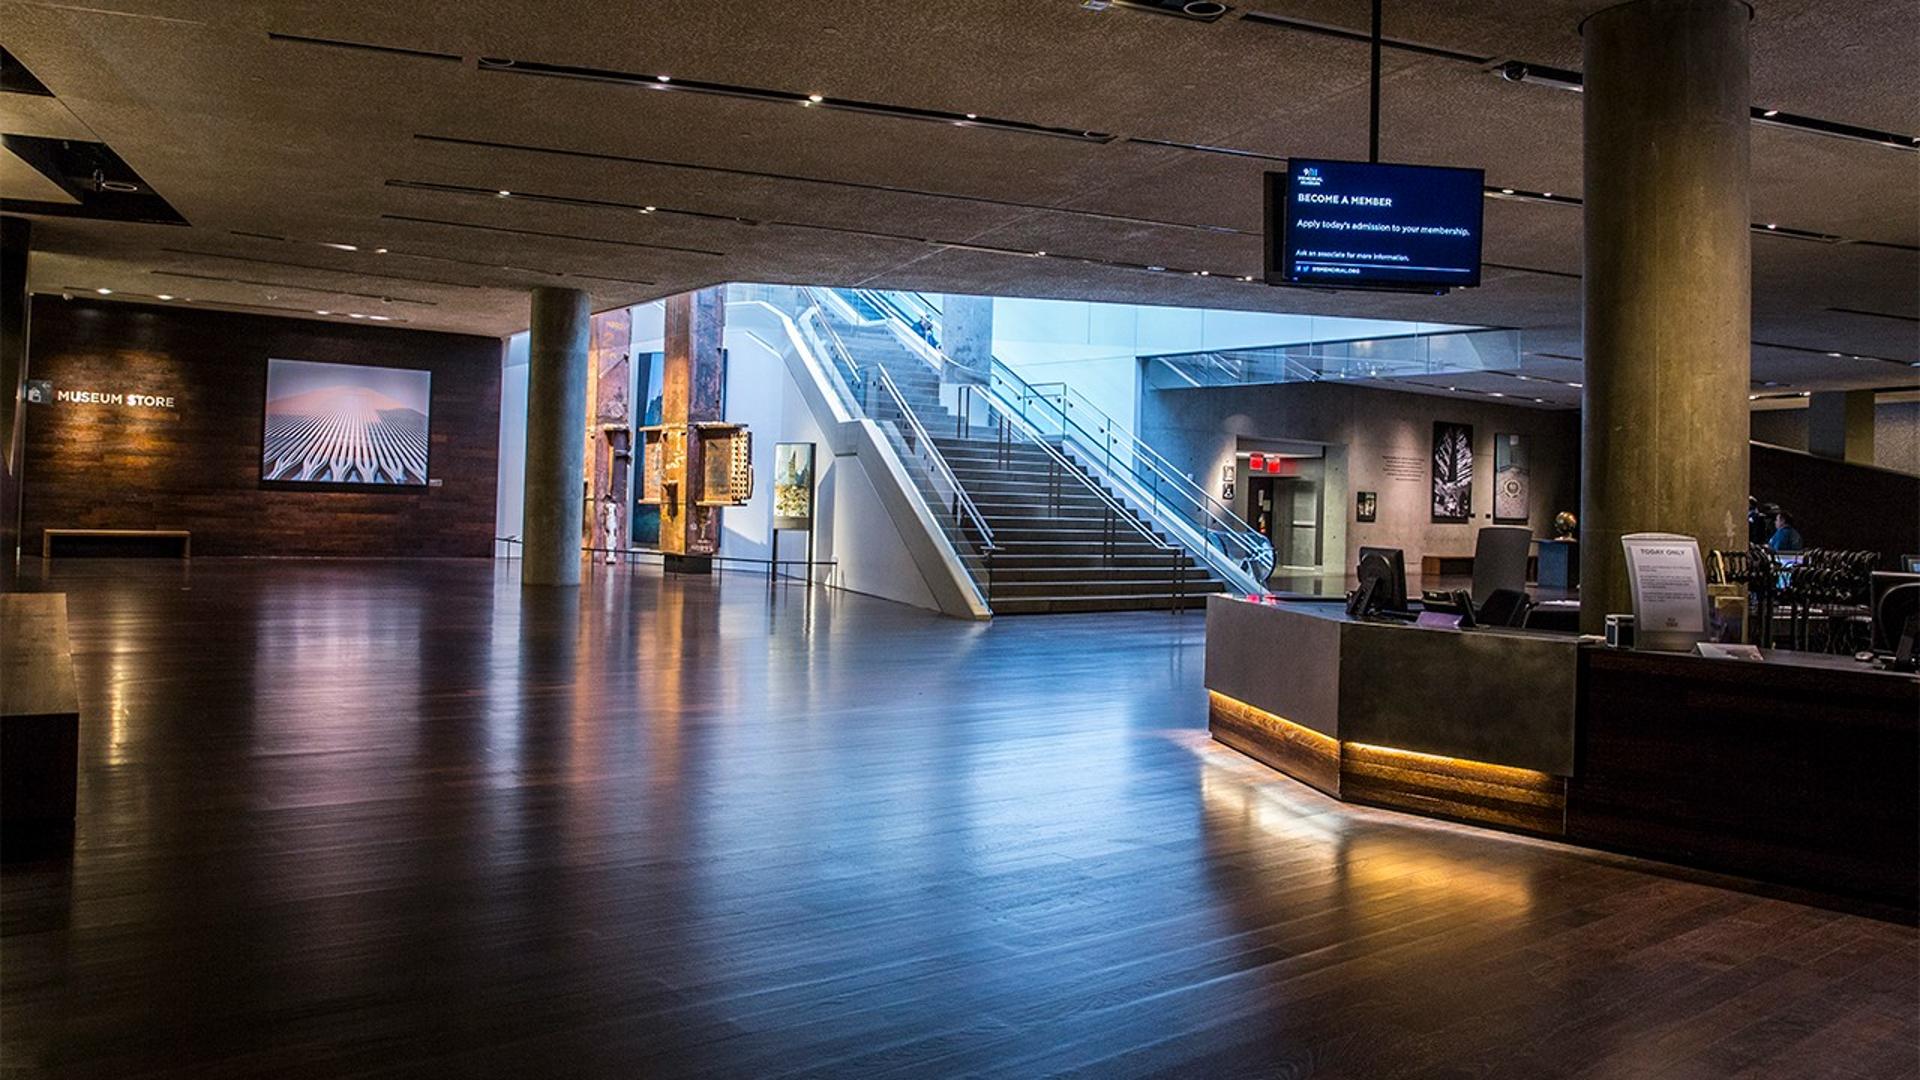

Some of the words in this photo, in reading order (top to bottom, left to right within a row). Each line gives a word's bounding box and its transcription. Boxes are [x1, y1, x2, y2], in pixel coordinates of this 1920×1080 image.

[1298, 193, 1339, 203] BECOME
[1340, 195, 1350, 205] A
[1351, 196, 1393, 207] MEMBER
[1296, 219, 1321, 230] Apply
[1322, 220, 1351, 231] today's
[1352, 221, 1391, 232] admission
[1391, 224, 1401, 233] to
[1402, 225, 1420, 234] your
[1420, 226, 1471, 237] membership.
[1295, 249, 1308, 257] Ask
[1318, 251, 1346, 259] associate
[58, 391, 122, 404] MUSEUM
[127, 394, 174, 407] STORE
[1640, 548, 1664, 556] TODAY
